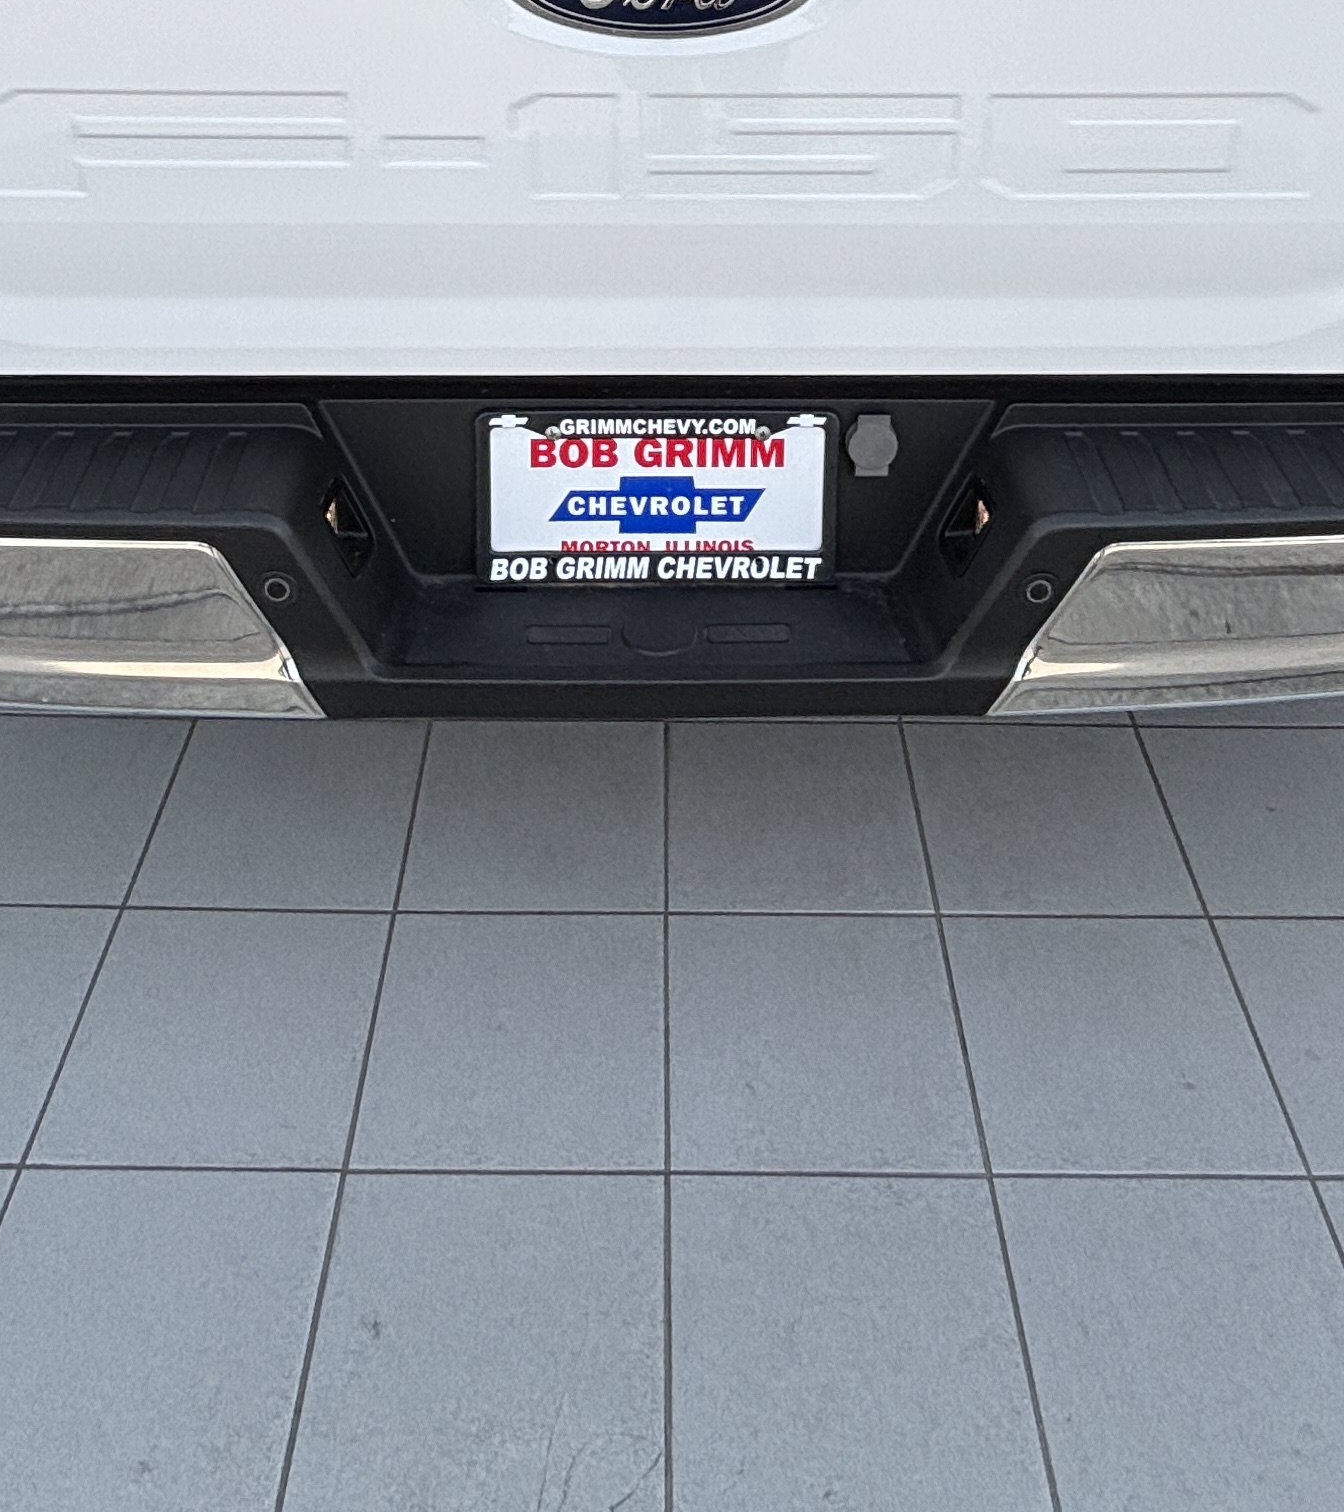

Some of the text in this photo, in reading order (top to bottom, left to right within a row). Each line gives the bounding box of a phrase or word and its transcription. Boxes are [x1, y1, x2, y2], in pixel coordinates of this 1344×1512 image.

[560, 418, 757, 436] GRIMMCHEVY.COM
[530, 437, 785, 468] BOB GRIMM
[567, 496, 745, 516] CHEVROLET
[490, 556, 823, 581] BOB GRIMM CHEVROLET
